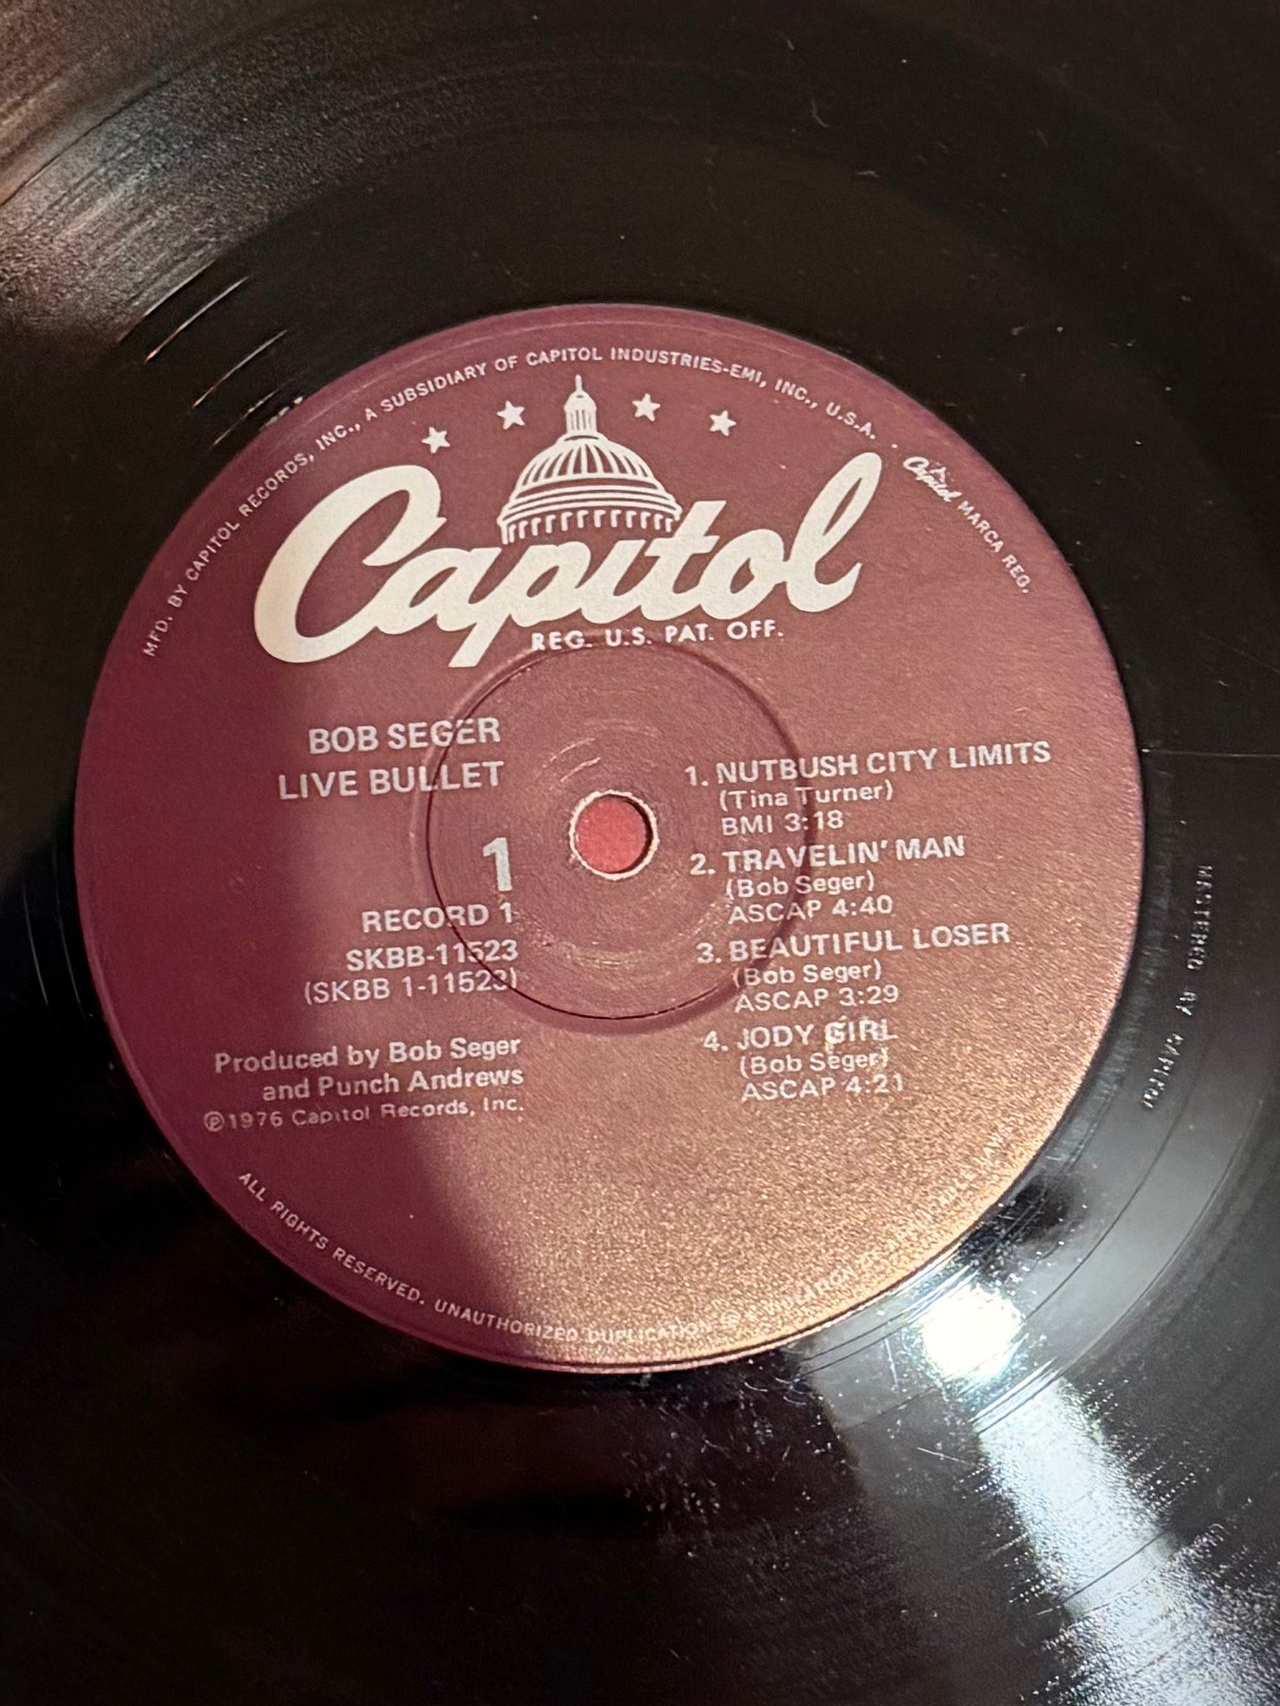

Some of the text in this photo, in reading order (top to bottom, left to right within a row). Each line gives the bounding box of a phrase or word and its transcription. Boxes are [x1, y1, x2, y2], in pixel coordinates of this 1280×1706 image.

[144, 616, 173, 657] MFD.
[167, 584, 188, 608] BY
[185, 520, 241, 581] CAPITOL
[238, 452, 315, 518] RECORDS,
[315, 423, 361, 451] INC.,
[364, 407, 378, 422] A
[380, 362, 487, 413] SUBSIDIARY
[494, 355, 518, 372] OF
[525, 347, 603, 366] CAPITOL
[610, 347, 768, 389] INDUSTRIES-EMI,
[774, 378, 818, 410] INC.,
[825, 401, 876, 440] U.S.A.
[957, 500, 1004, 553] MARCA
[1001, 553, 1031, 594] REG.
[254, 451, 882, 669] Capitol
[531, 619, 784, 652] REG. U.S. PAT. OFF.
[309, 717, 501, 754] BOB SEGER
[684, 740, 1051, 787] 1. NUTBUSH CITY LIMITS
[278, 761, 504, 800] LIVE BULLET
[719, 780, 894, 813] (Tina Turner)
[721, 810, 845, 836] BMI 3:18
[482, 837, 513, 892] 1
[689, 853, 715, 875] 2.
[895, 835, 966, 861] MAN
[726, 870, 874, 900] (Bob Seger)
[362, 902, 515, 933] RECORD 1
[728, 896, 893, 924] ASCAP 4:40
[346, 940, 519, 972] SKBB-11523
[696, 922, 1010, 964] 3. BEAUTIFUL LOSER
[304, 967, 519, 1005] (SKBB 1-11523)
[732, 960, 881, 989] (Bob Seger)
[734, 985, 898, 1013] ASCAP 3:29
[703, 1018, 898, 1051] 4. JODY GIRL
[215, 1036, 522, 1074] Produced by Bob Seger
[739, 1048, 889, 1078] (Bob Seger)
[262, 1066, 524, 1101] and Punch Andrews
[741, 1073, 903, 1101] ASCAP 4:21
[292, 1106, 371, 1127] Capitol
[381, 1099, 475, 1119] Records,
[483, 1096, 524, 1114] Inc.
[238, 1172, 265, 1202] ALL
[271, 1200, 329, 1250] RIGHTS
[332, 1247, 424, 1305] RESERVED.
[434, 1299, 579, 1342] UNAUTHORIZED
